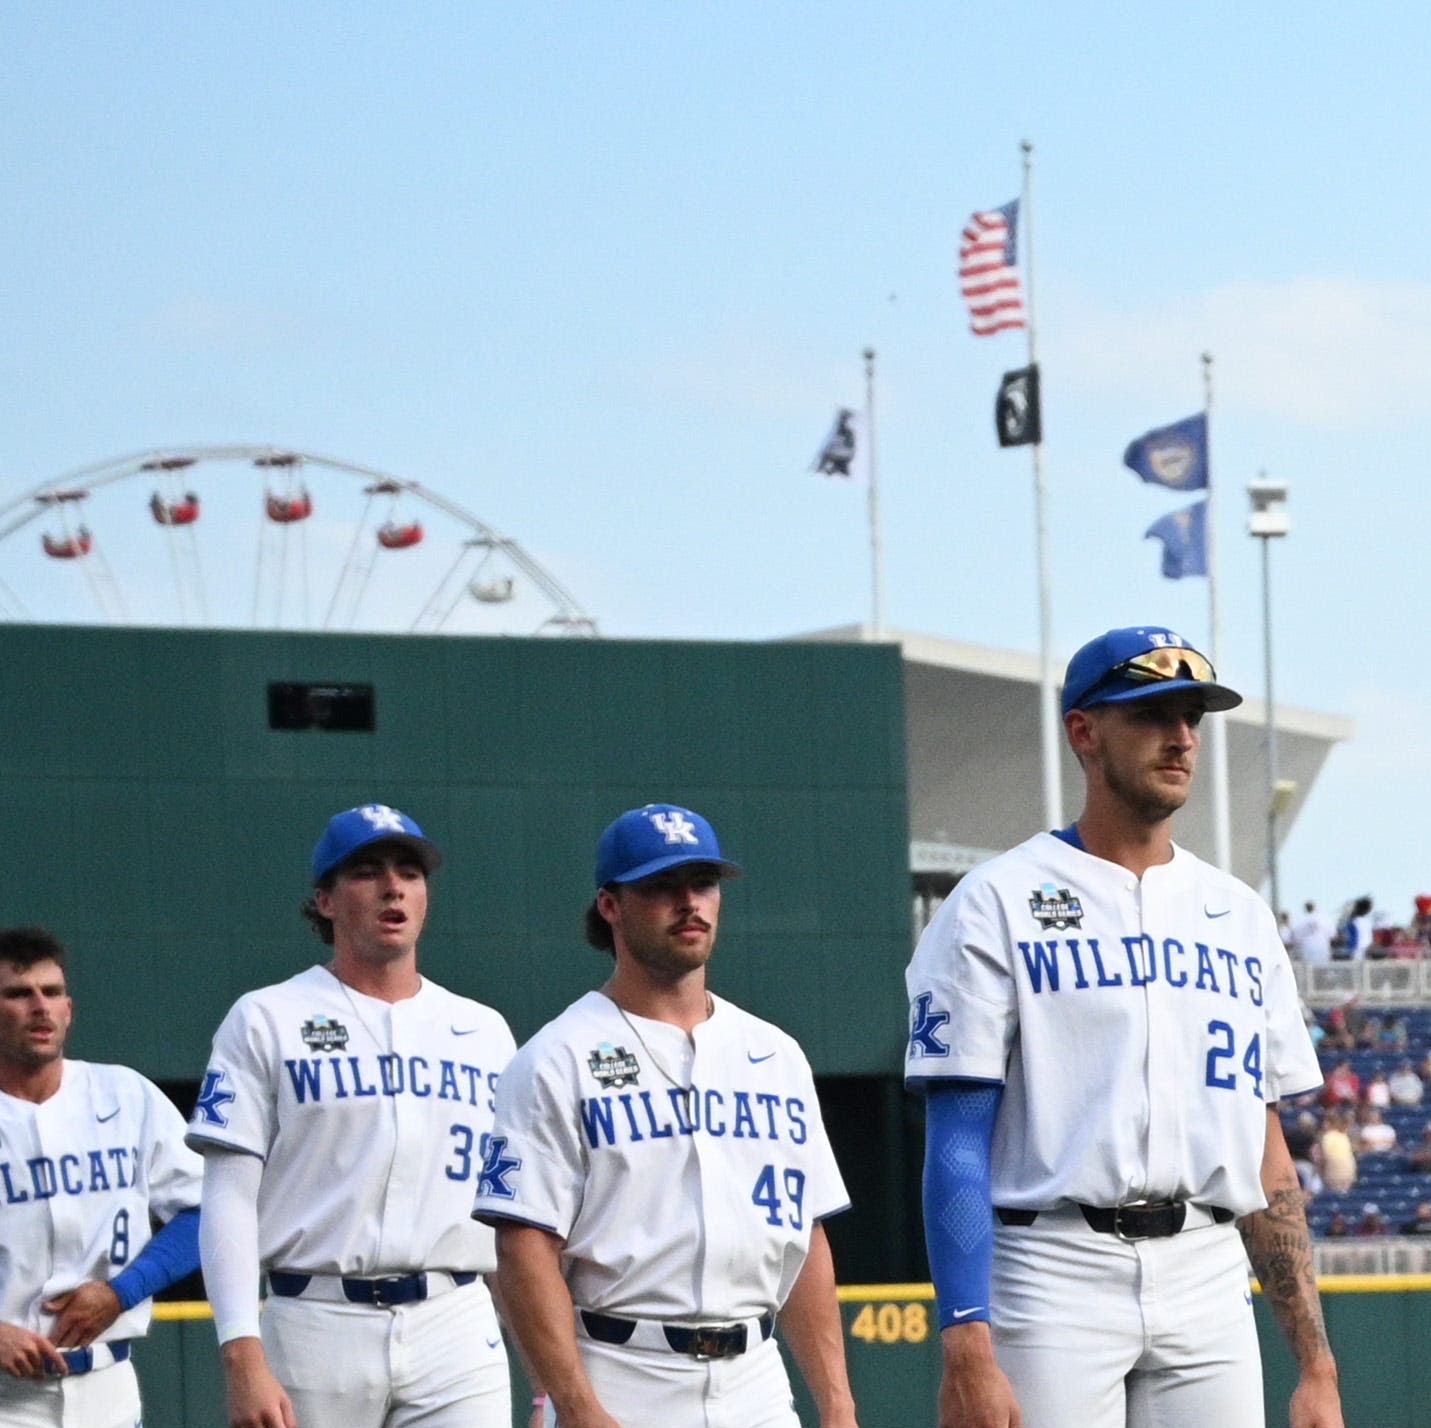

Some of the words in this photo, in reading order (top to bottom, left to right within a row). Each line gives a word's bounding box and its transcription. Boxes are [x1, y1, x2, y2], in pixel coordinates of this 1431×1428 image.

[650, 811, 700, 846] UK
[1018, 933, 1265, 1007] WILDCATS
[1205, 1019, 1264, 1099] 24
[580, 1083, 807, 1149] WILDCATS
[751, 1164, 806, 1231] 49
[110, 1207, 130, 1266] 8
[851, 1302, 928, 1343] 408
